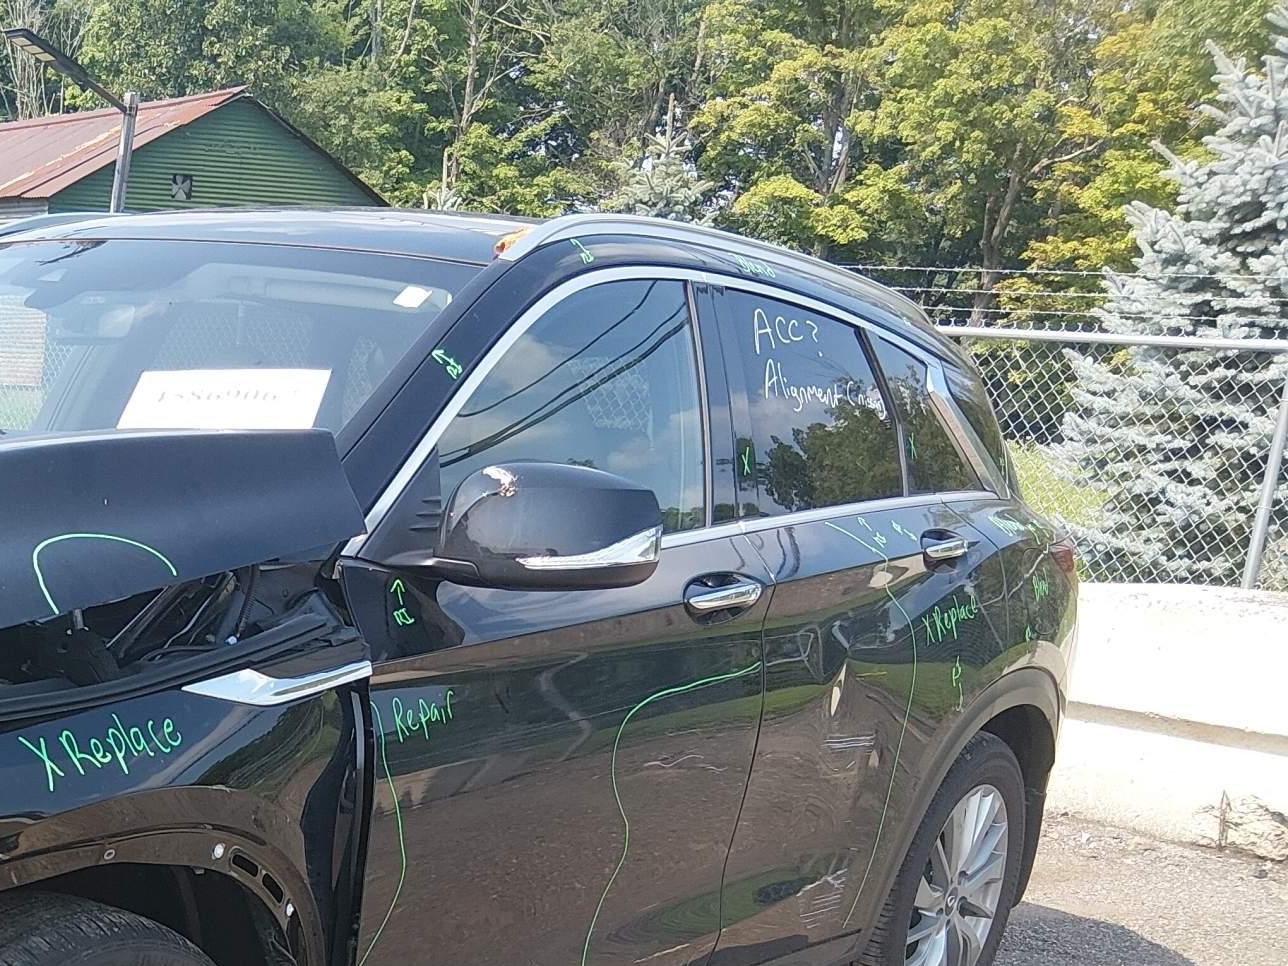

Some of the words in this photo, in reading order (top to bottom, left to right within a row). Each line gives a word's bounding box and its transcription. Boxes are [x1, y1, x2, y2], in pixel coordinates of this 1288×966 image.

[753, 308, 824, 357] ACC?
[765, 358, 843, 413] Alignment
[932, 593, 978, 643] Replace
[392, 690, 454, 744] Repair
[60, 713, 183, 776] Replace
